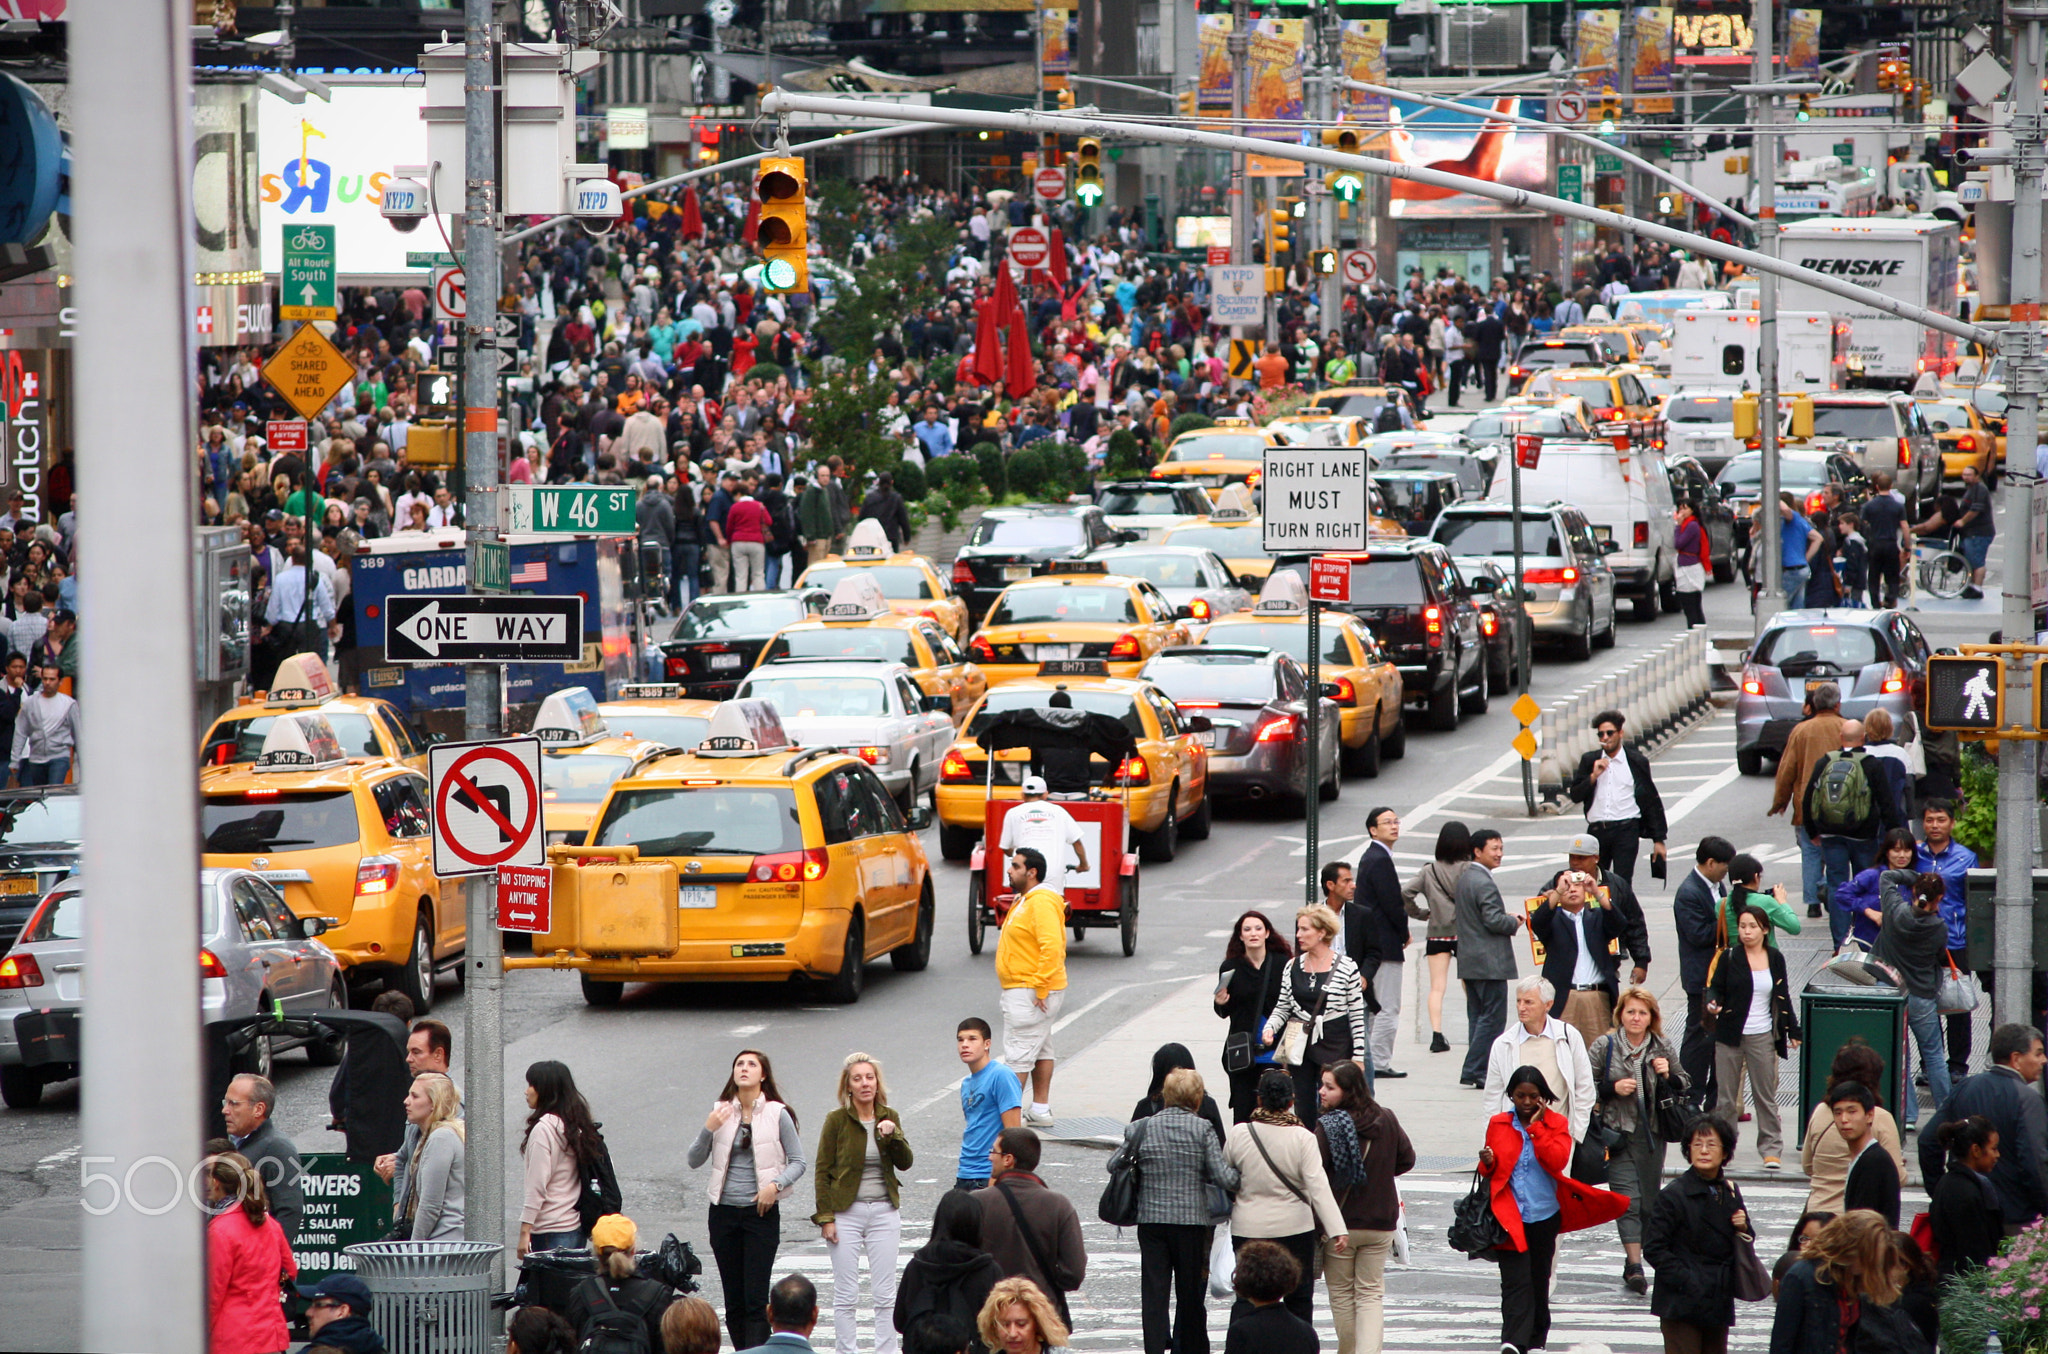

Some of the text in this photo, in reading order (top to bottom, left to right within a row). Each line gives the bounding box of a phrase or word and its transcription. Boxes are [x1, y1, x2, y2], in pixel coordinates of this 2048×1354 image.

[1963, 188, 1982, 200] NYPD
[385, 191, 414, 210] NYPD
[578, 191, 608, 210] NYPD
[1775, 200, 1816, 208] POLICE
[288, 258, 330, 268] Alt Route
[1801, 258, 1905, 275] PENSKE
[291, 269, 327, 282] South
[1222, 270, 1254, 281] NYPD
[290, 360, 328, 371] SHARED
[297, 373, 321, 384] ZONE
[294, 387, 325, 397] AHEAD
[273, 431, 300, 439] ANYTIME
[1269, 462, 1361, 478] RIGHT LANE
[1289, 490, 1341, 510] MUST
[540, 491, 629, 528] W 46 ST
[1268, 522, 1362, 538] TURN RIGHT
[360, 557, 385, 569] 389
[1313, 562, 1348, 575] NO STOPPING
[403, 565, 467, 591] GARDA
[1319, 574, 1342, 585] ANYTIME
[416, 616, 554, 641] ONE WAY
[1061, 661, 1086, 672] 8H73
[639, 687, 663, 697] 5B89
[541, 730, 564, 740] 1J97
[713, 738, 741, 749] 1P19
[274, 751, 298, 764] 3K79
[501, 872, 547, 889] NO STOPPING
[508, 891, 539, 906] ANYTIME
[309, 1218, 354, 1230] SALARY
[293, 1233, 337, 1245] AINING
